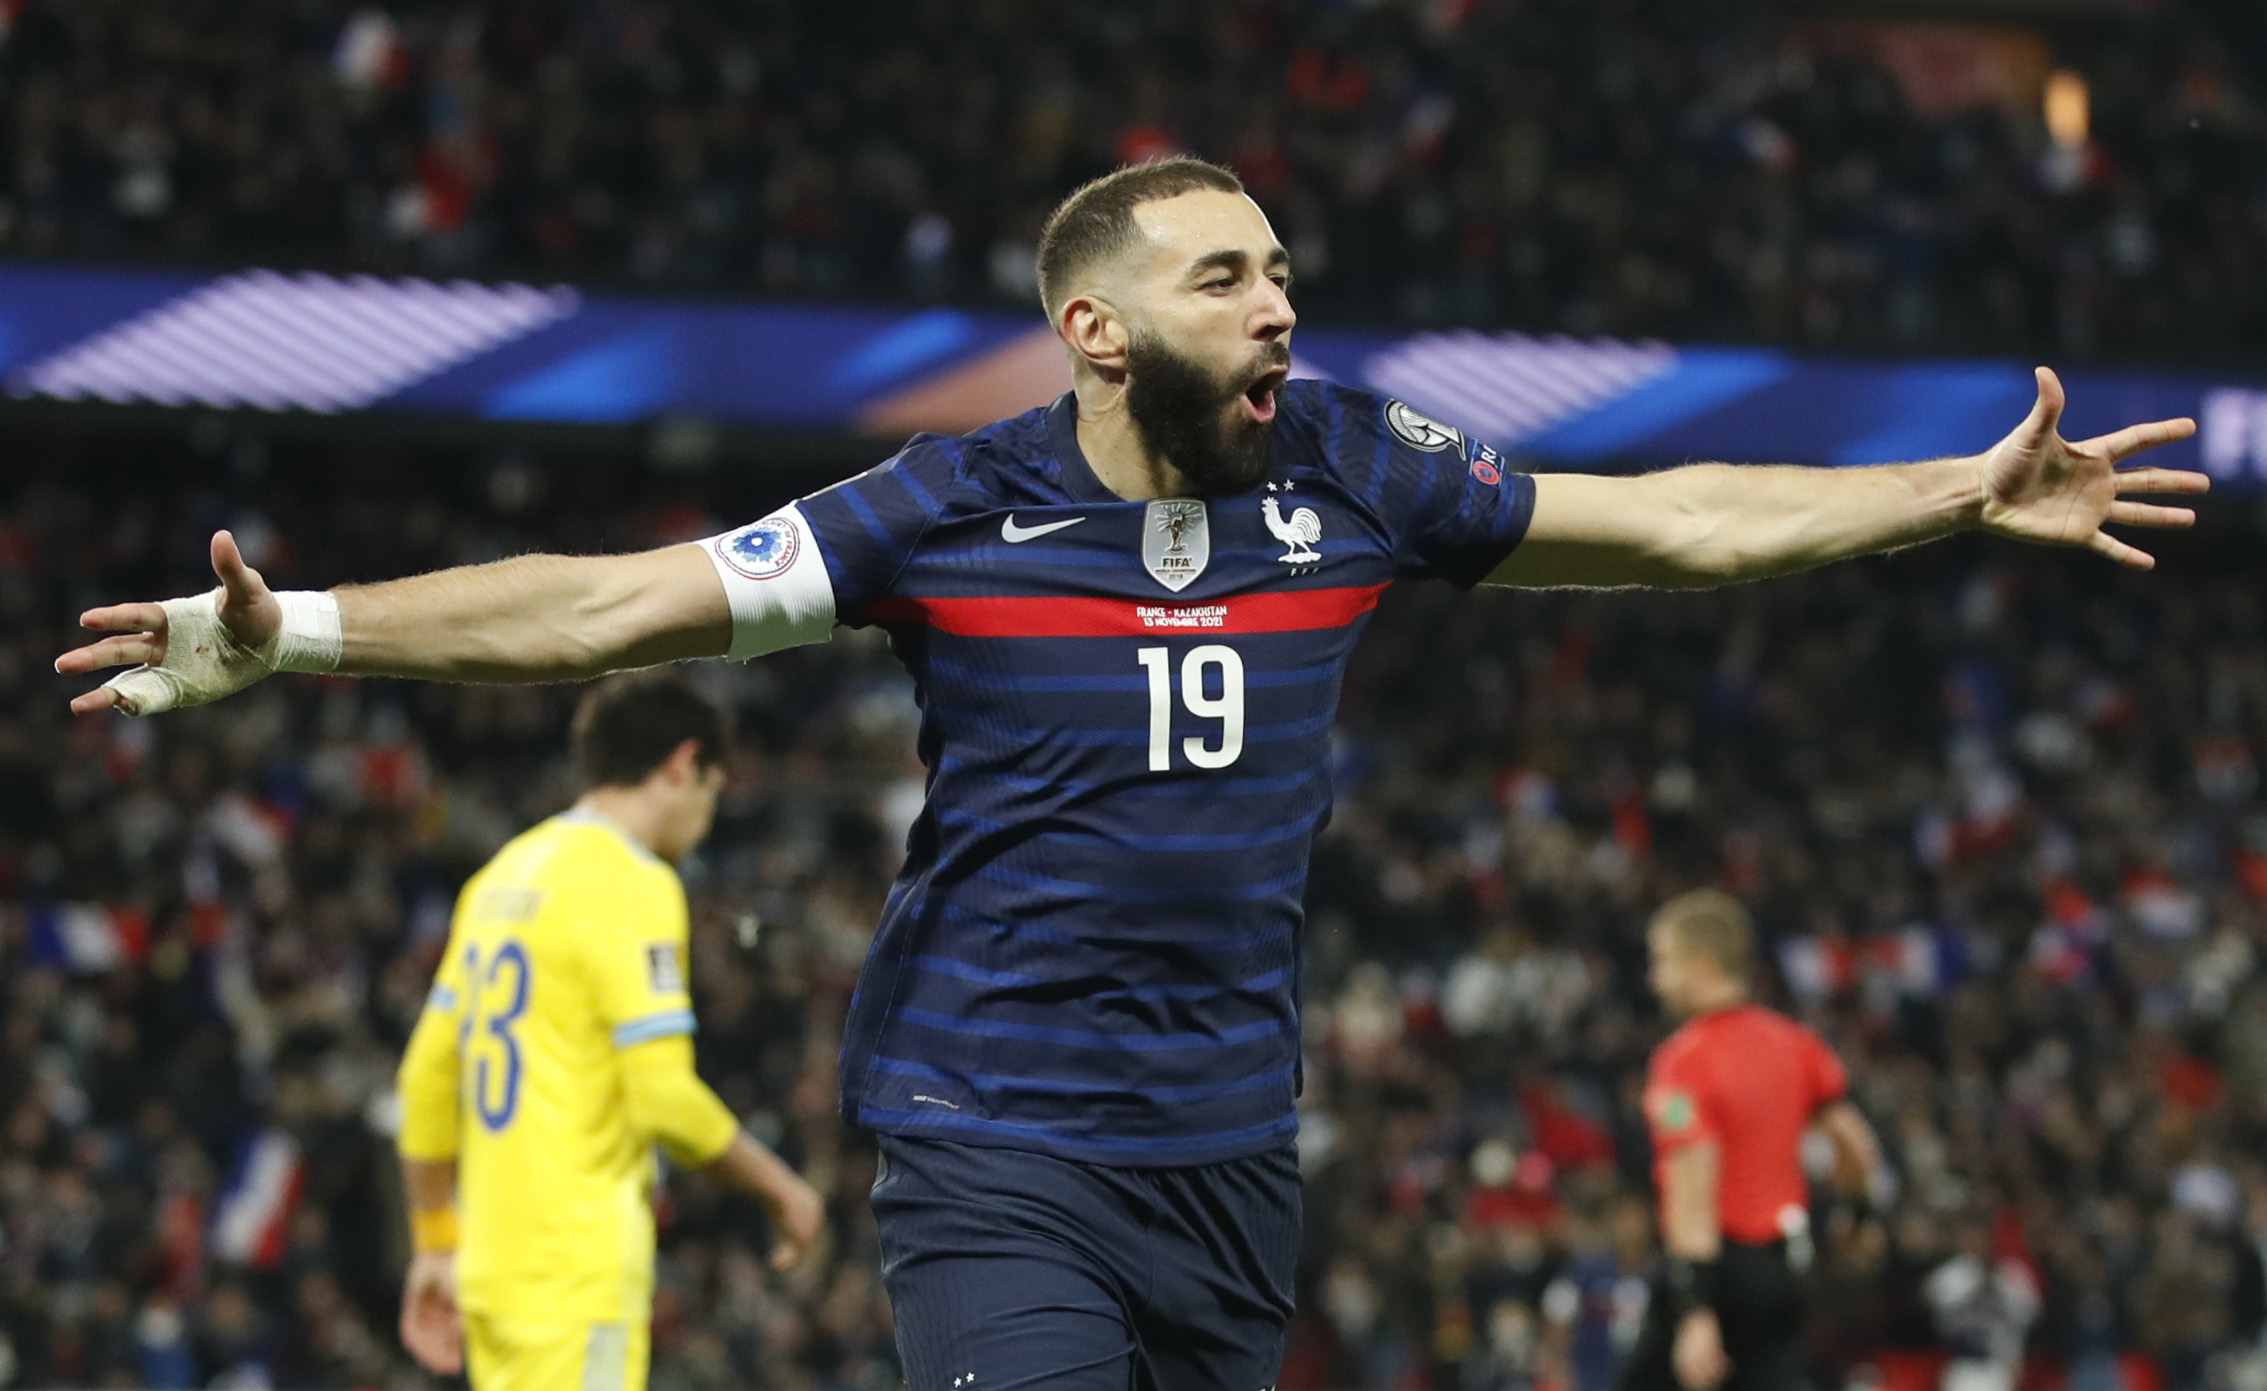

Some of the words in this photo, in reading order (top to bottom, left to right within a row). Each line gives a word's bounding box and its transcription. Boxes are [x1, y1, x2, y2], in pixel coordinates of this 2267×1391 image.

[1162, 557, 1190, 568] FIFA
[1136, 606, 1166, 617] FRANCE
[1173, 605, 1228, 617] KAZAKHSTAN
[1143, 617, 1154, 627] 13
[1155, 617, 1199, 627] NOVEMBRE
[1200, 616, 1223, 627] 2021
[1137, 644, 1245, 772] 19
